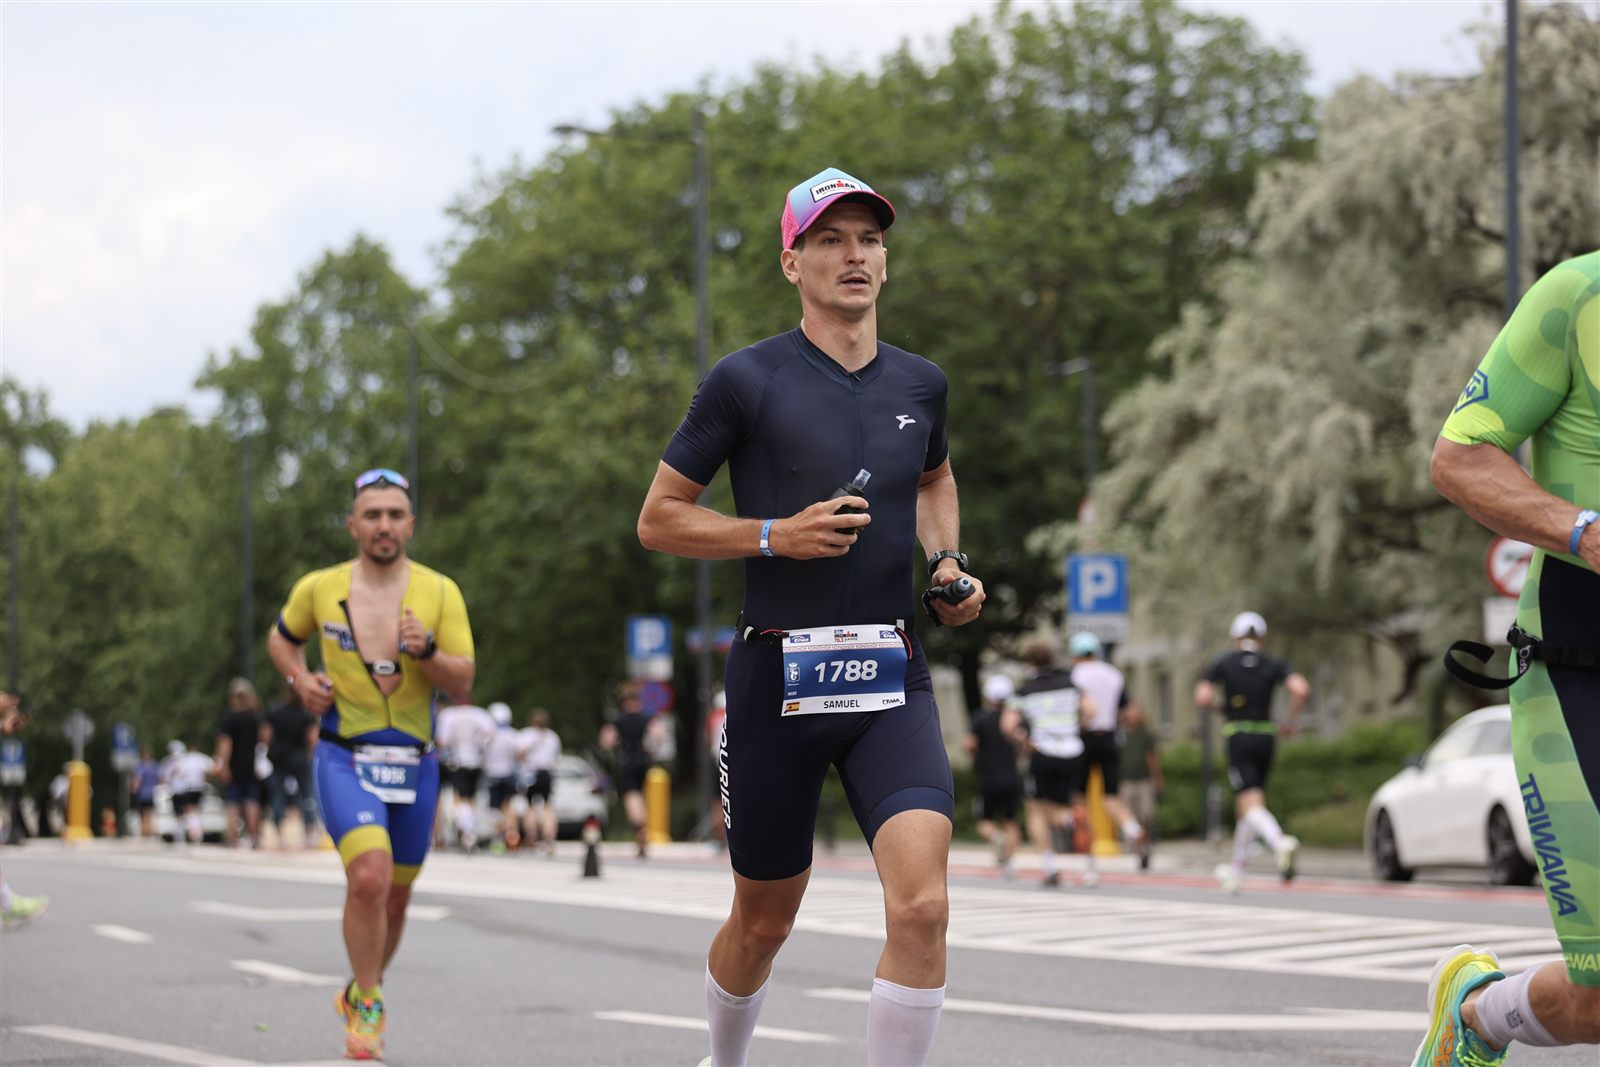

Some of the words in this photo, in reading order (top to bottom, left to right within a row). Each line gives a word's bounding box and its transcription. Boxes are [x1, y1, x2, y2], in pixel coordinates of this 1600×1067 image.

[1079, 560, 1118, 612] P
[633, 617, 667, 658] P
[814, 660, 878, 682] 1788
[823, 699, 860, 709] SAMUEL
[1520, 772, 1578, 917] TRIWAWA
